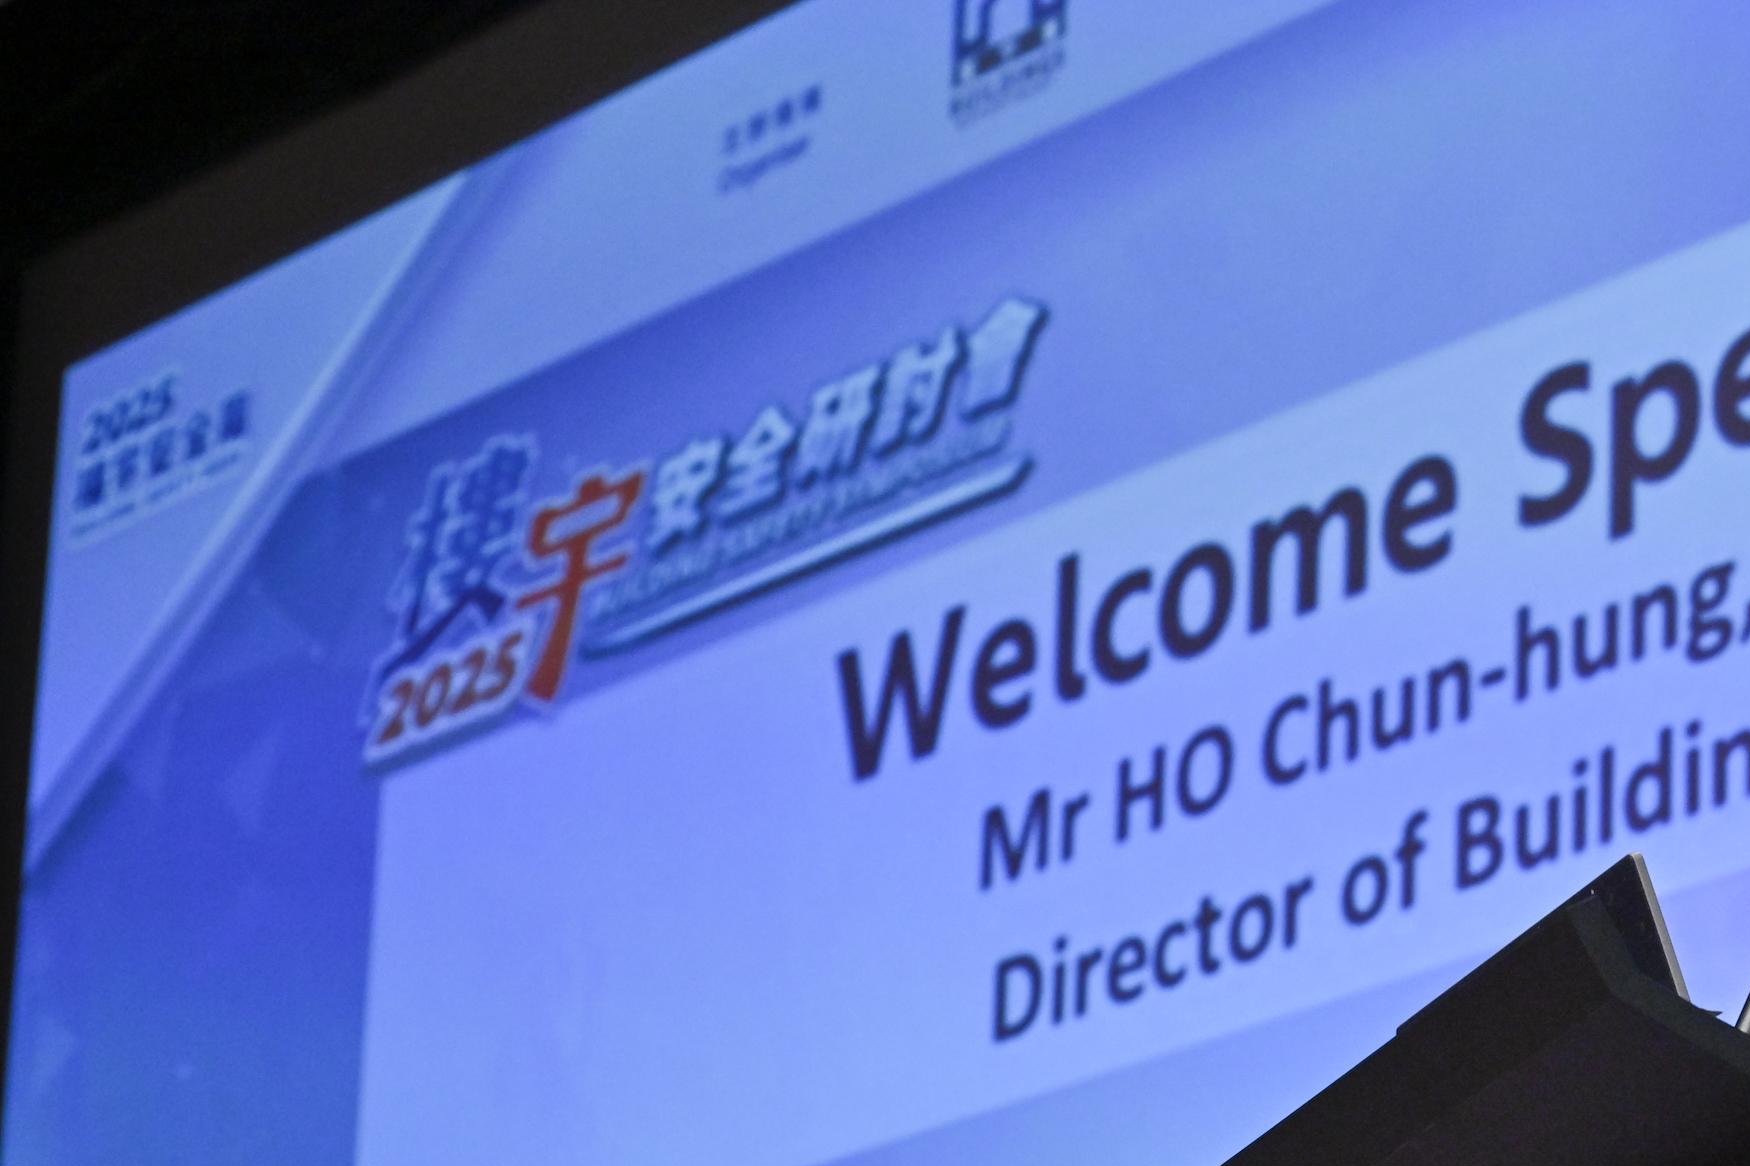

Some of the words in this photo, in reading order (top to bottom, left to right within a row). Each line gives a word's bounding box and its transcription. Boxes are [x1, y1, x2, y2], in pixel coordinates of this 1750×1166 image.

[376, 626, 525, 746] 2025
[836, 454, 1458, 784] Welcome
[979, 786, 1090, 892] Mr
[1115, 724, 1234, 844] HO
[991, 875, 1314, 1044] Director
[1341, 808, 1429, 927] of
